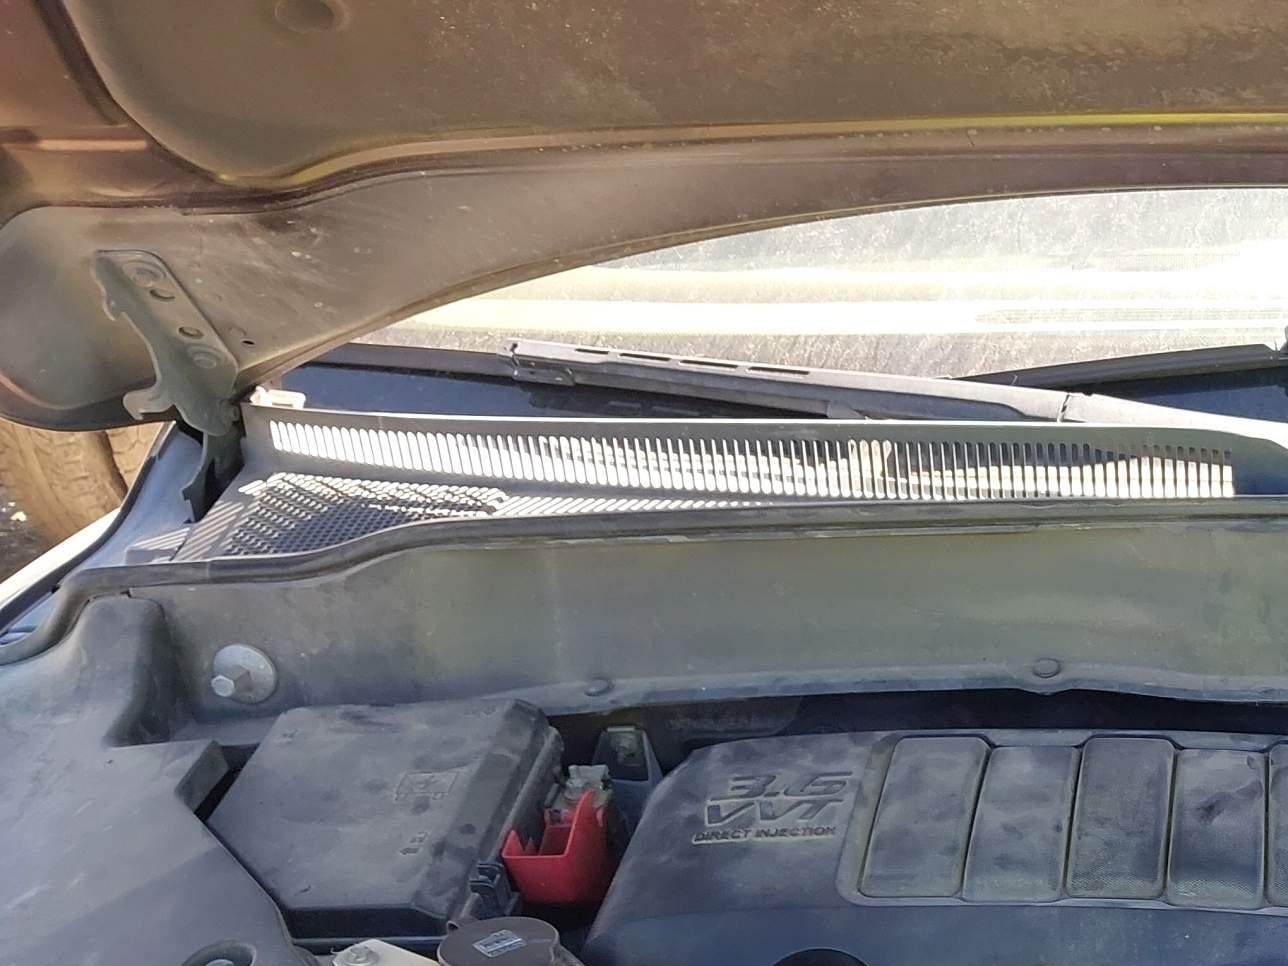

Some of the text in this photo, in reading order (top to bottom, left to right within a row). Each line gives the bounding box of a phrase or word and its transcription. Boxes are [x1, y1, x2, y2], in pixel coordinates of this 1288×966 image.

[710, 771, 853, 800] 3.6
[706, 799, 845, 827] VVT
[692, 826, 836, 844] DIRECT INJECTION
